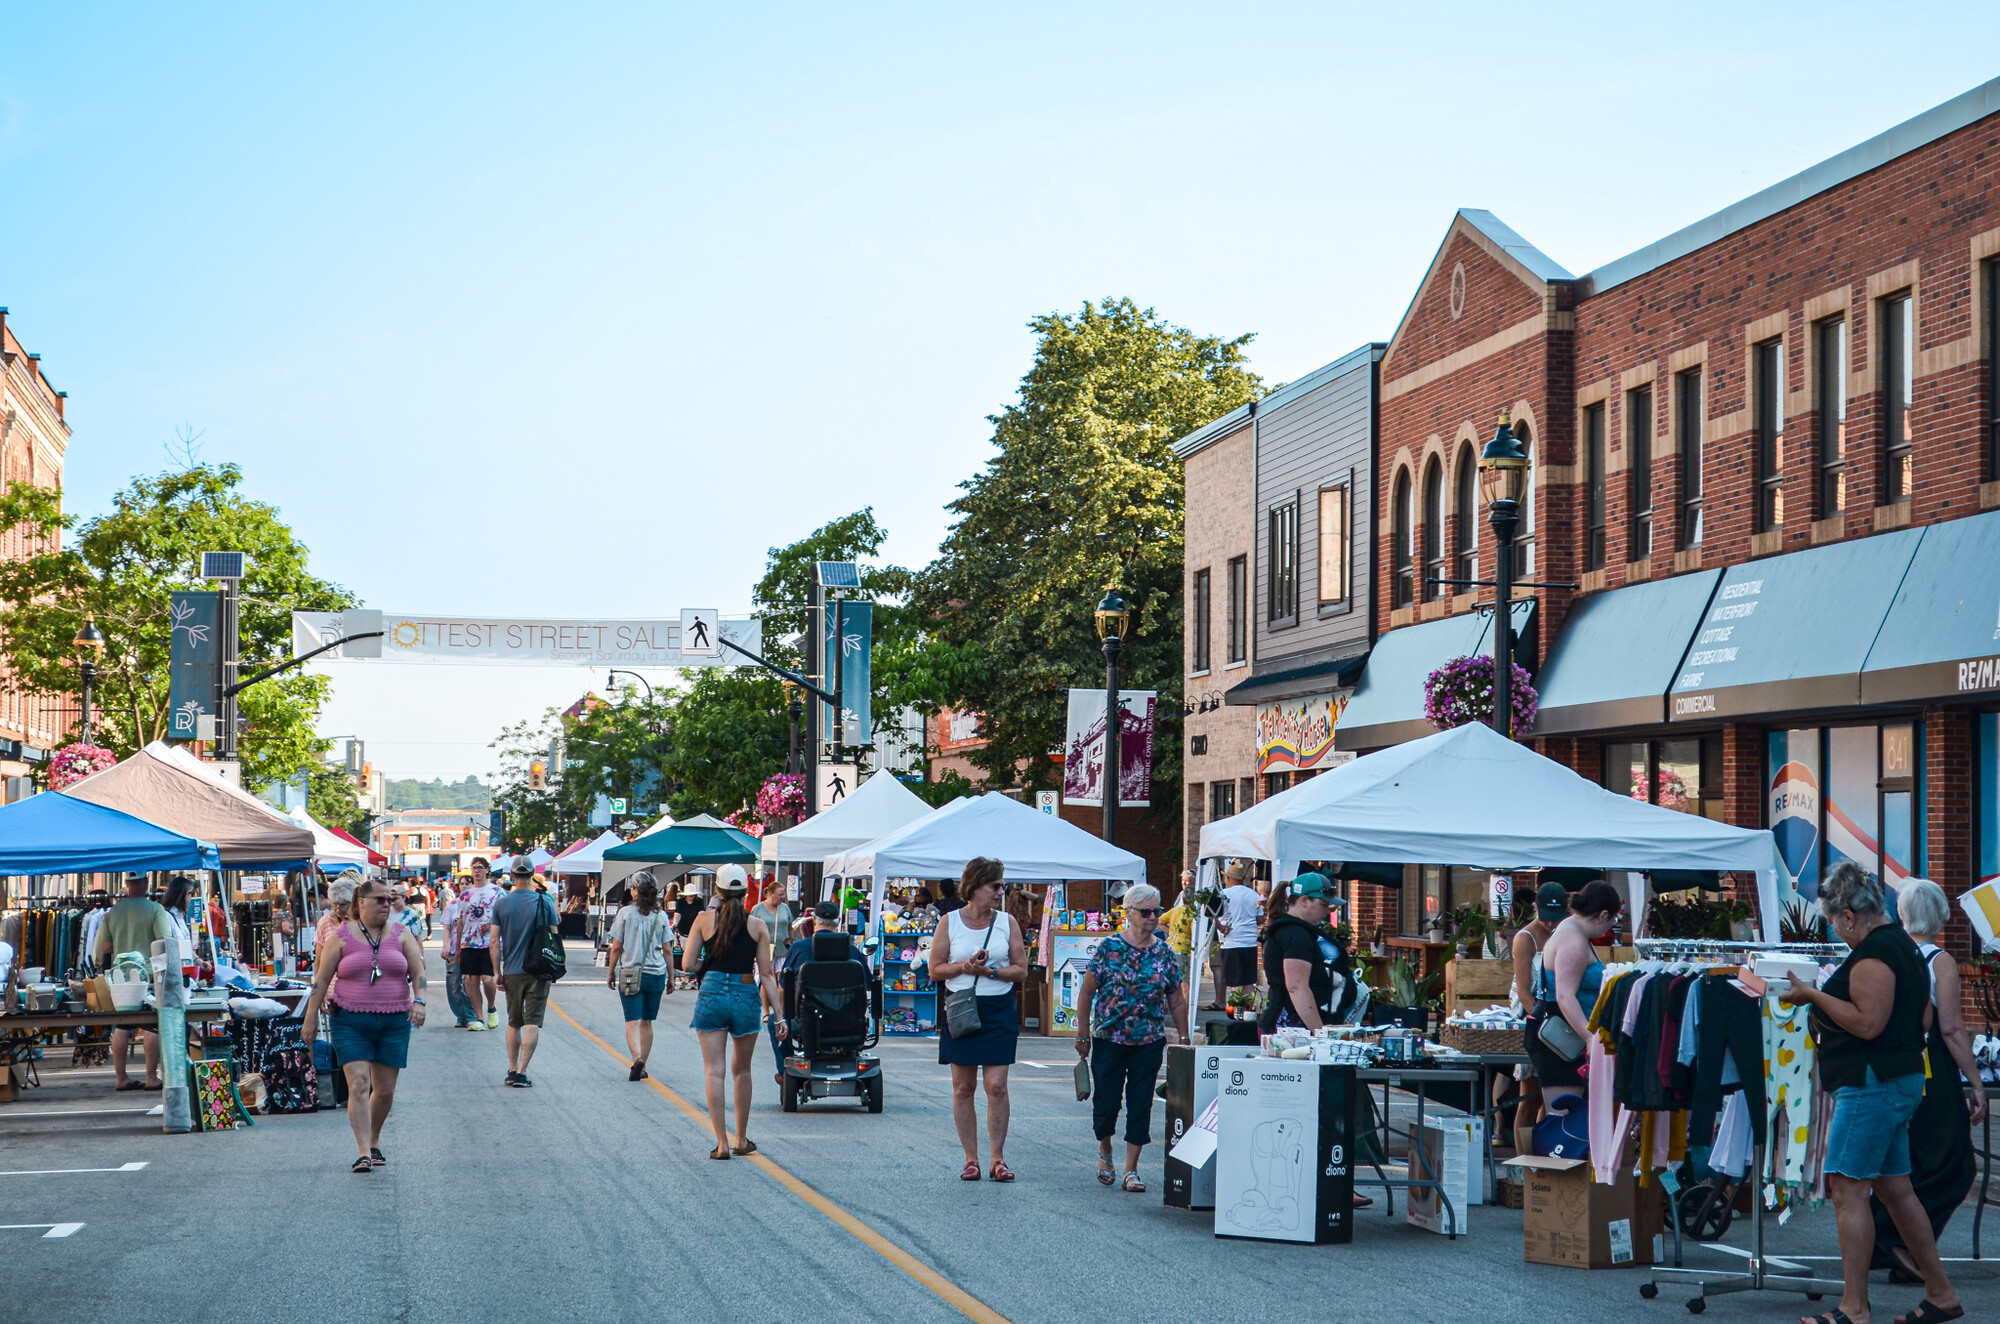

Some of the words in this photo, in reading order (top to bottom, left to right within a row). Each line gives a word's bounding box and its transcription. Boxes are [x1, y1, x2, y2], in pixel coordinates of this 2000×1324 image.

[1721, 580, 1763, 600] RESIDENTIAL
[1711, 602, 1757, 622] WATERFRONT
[506, 624, 608, 649] STREET
[616, 626, 681, 650] SALE
[1701, 627, 1733, 644] COTTAGE
[550, 649, 593, 661] Second
[596, 649, 645, 662] Saturday
[649, 649, 658, 660] in
[661, 649, 683, 663] July
[1690, 647, 1738, 666] RECREATIONAL
[1680, 673, 1704, 688] FARMS
[1676, 694, 1716, 715] COMMERCIAL
[1887, 735, 1908, 771] 841
[1143, 759, 1151, 796] HISTORIC
[1775, 791, 1814, 814] RE/MAX
[1201, 1070, 1219, 1080] dion
[1260, 1072, 1295, 1082] cambria
[1297, 1073, 1303, 1083] 2
[1225, 1087, 1249, 1097] diono
[1325, 1164, 1346, 1176] diono
[1531, 1182, 1552, 1193] Solana
